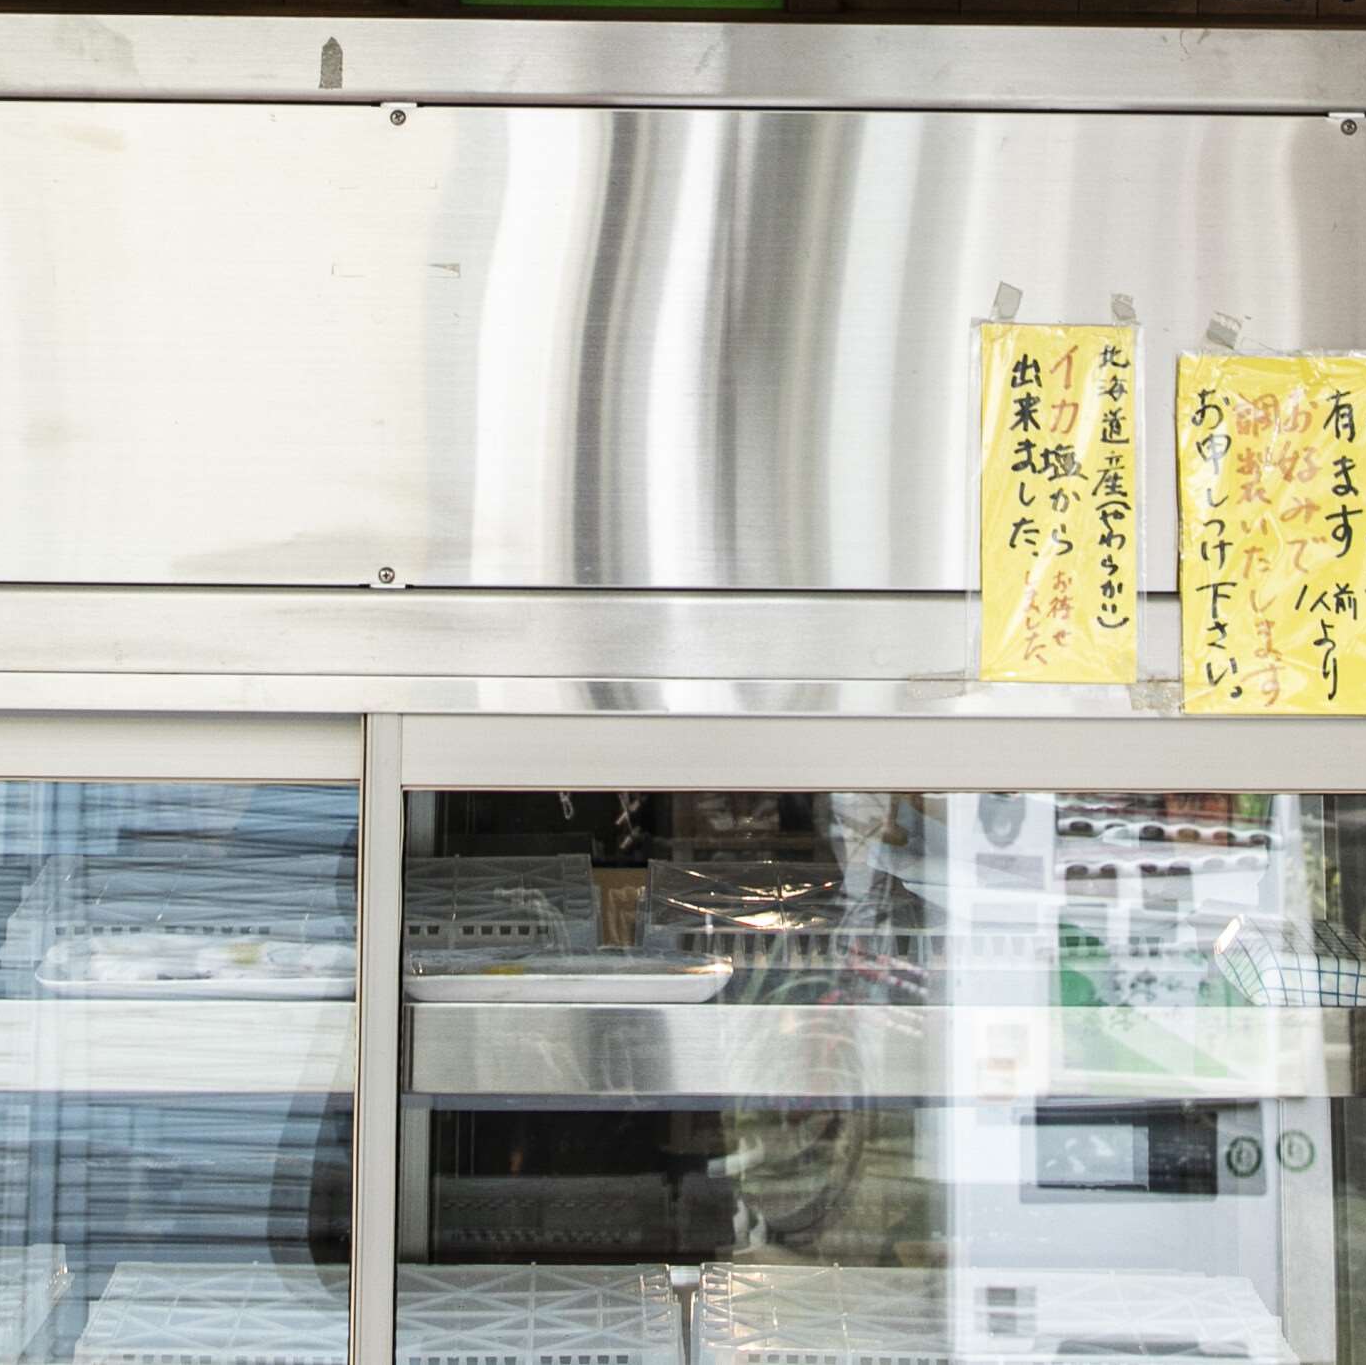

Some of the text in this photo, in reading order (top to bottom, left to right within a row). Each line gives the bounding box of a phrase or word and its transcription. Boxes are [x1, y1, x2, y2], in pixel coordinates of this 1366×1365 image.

[1040, 344, 1089, 557] イカ塩から
[1190, 388, 1244, 700] お申しつけ下さい。
[1323, 389, 1364, 559] 有ます
